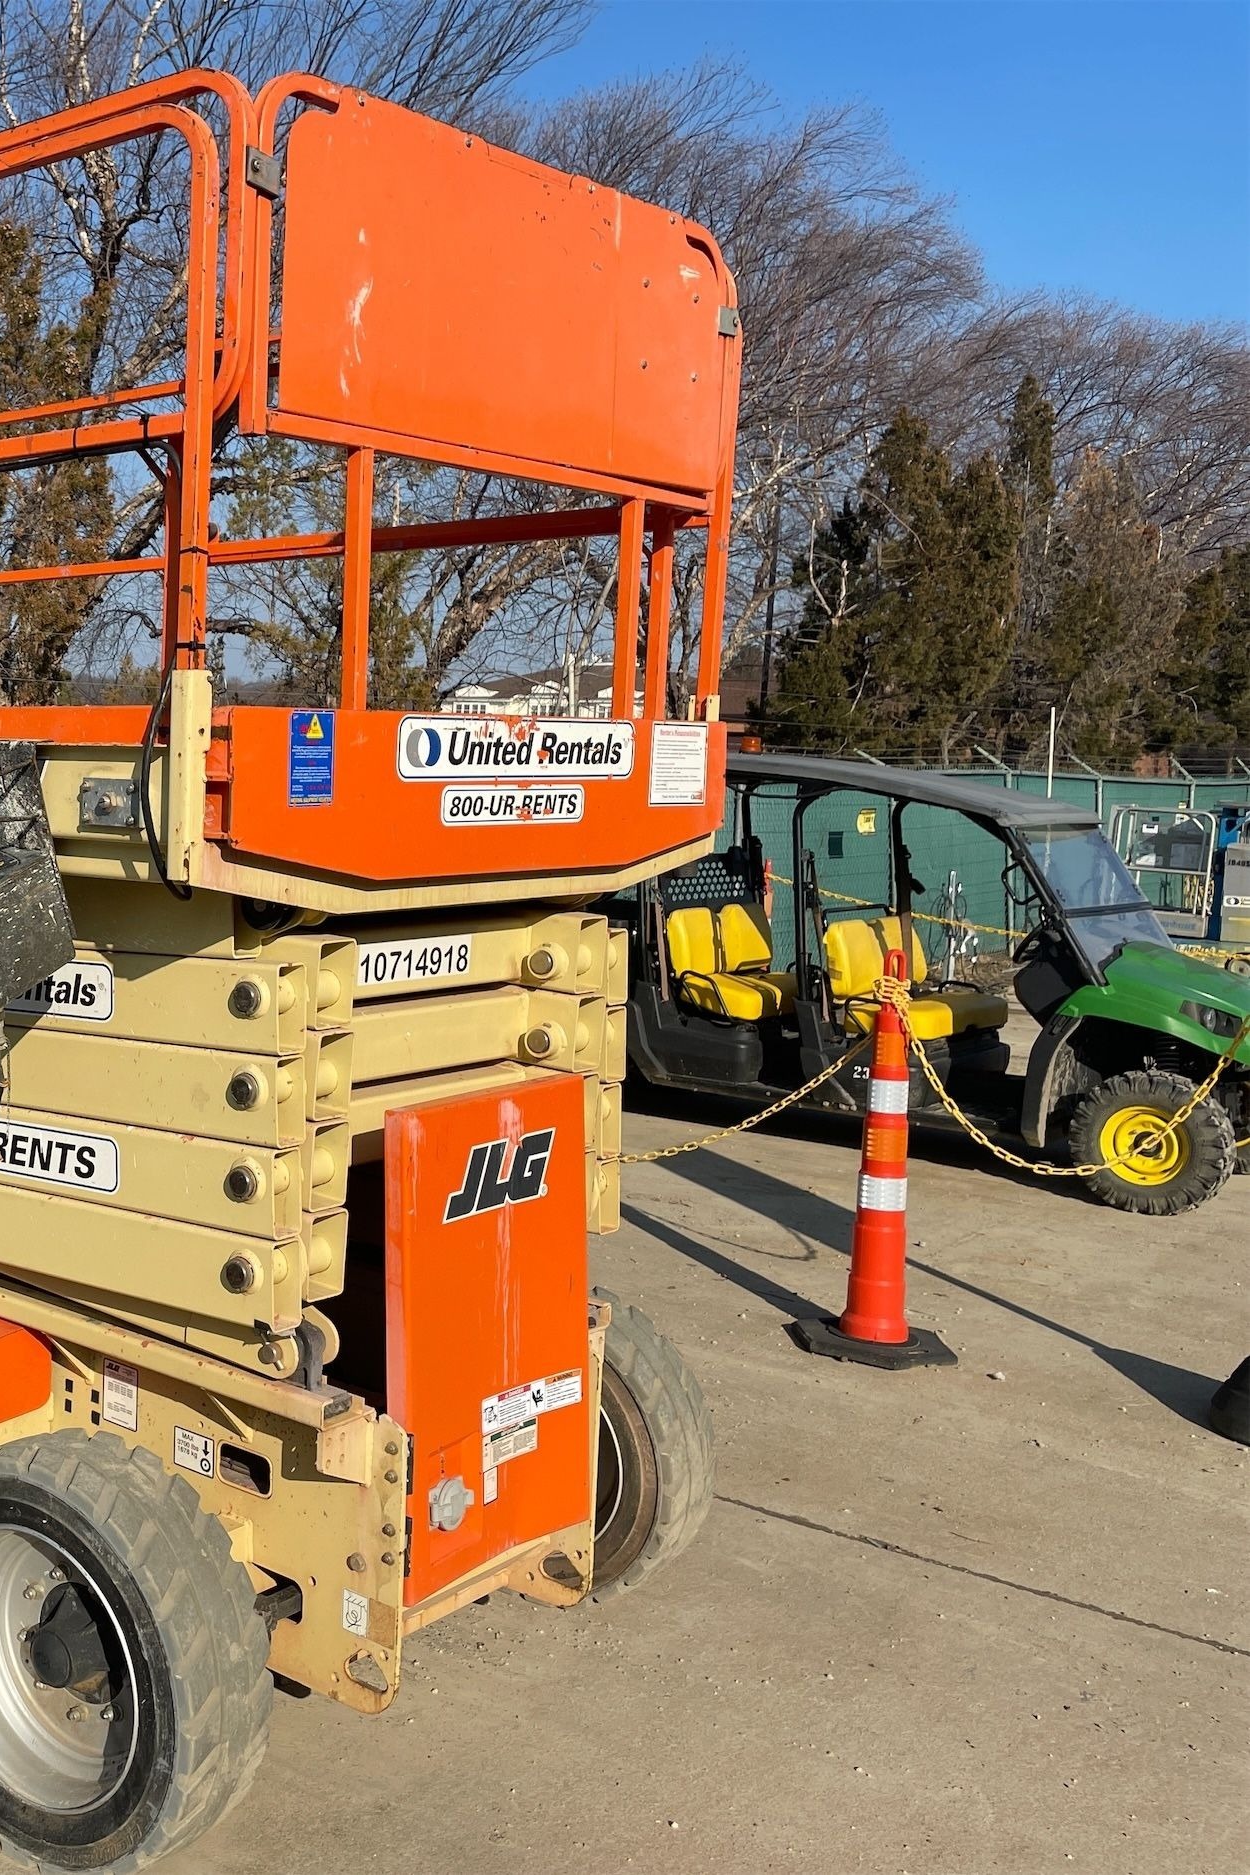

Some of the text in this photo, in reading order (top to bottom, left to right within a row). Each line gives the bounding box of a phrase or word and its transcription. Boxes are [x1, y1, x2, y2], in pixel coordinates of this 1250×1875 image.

[448, 731, 534, 766] United
[537, 732, 623, 765] Rentals
[360, 944, 469, 983] 10714918
[444, 1130, 555, 1221] JLG
[181, 1432, 195, 1442] MAX
